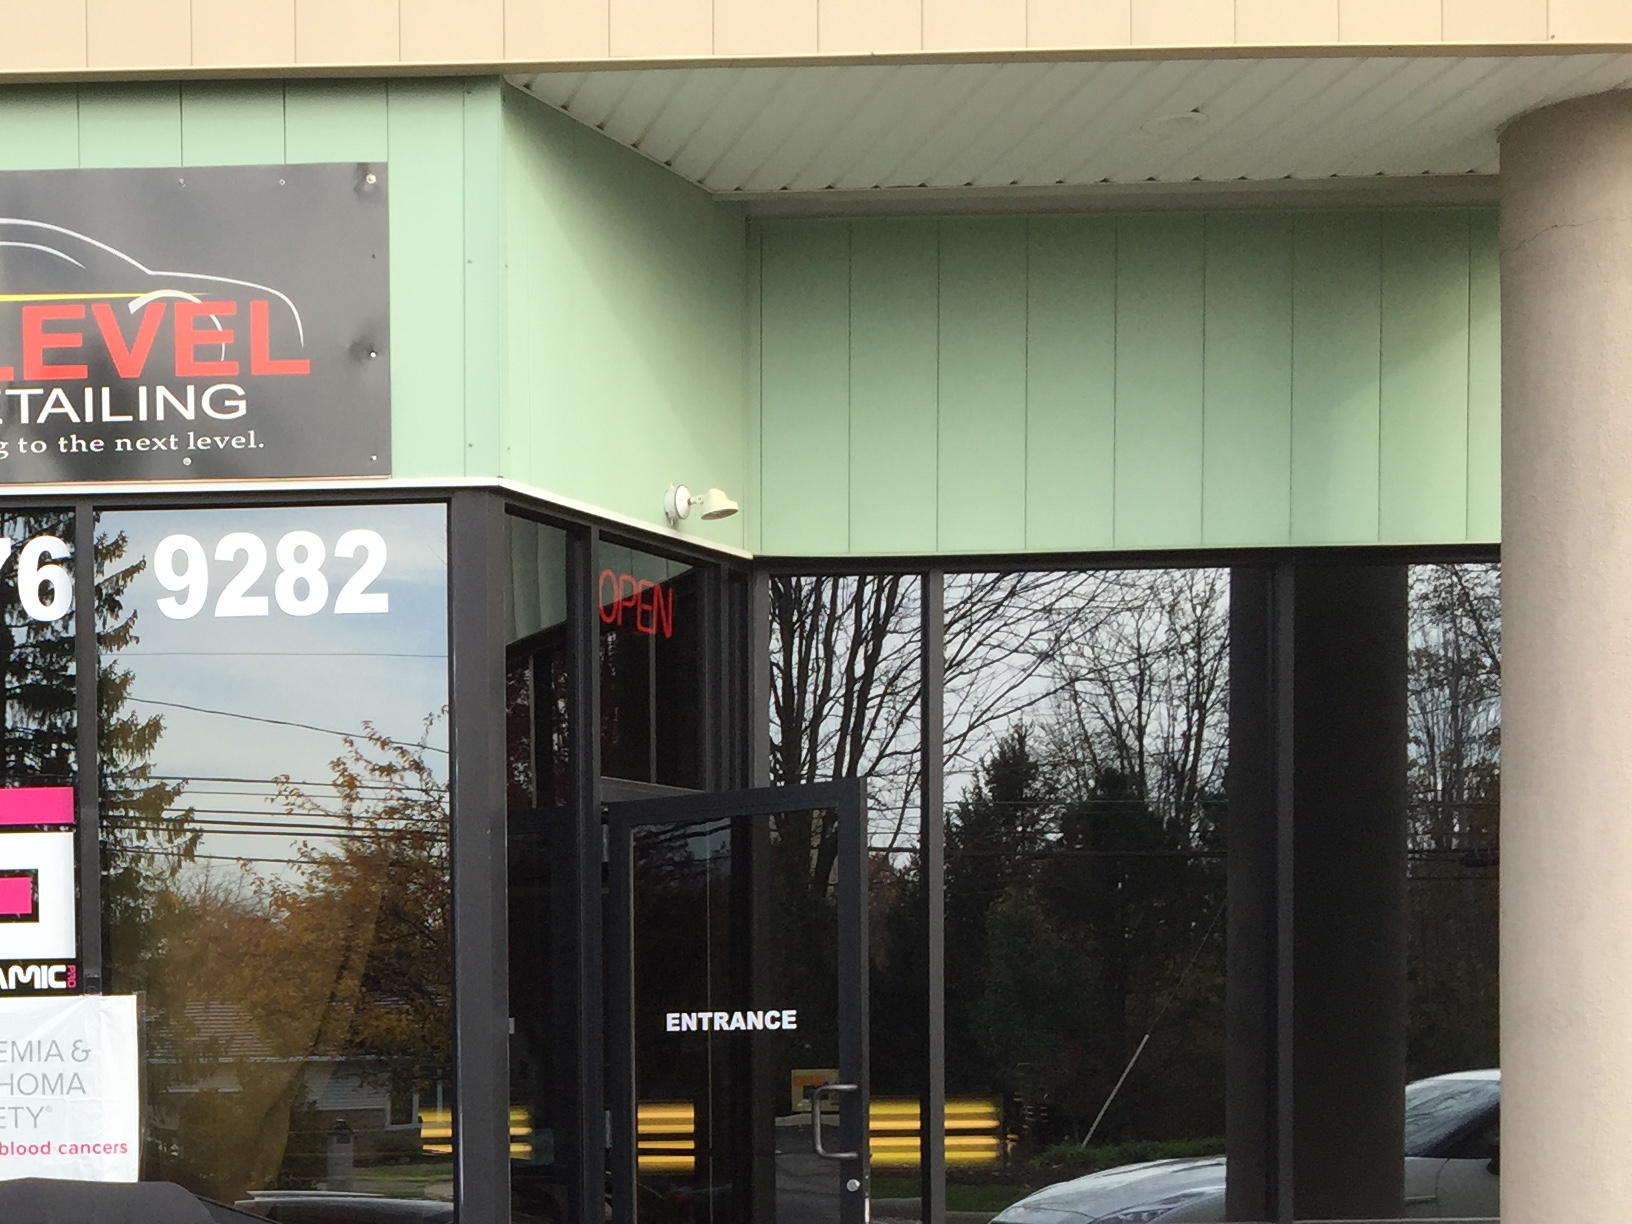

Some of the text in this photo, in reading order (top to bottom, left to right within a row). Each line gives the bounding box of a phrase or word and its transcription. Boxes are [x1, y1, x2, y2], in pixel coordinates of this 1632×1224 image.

[17, 436, 47, 454] to
[57, 434, 104, 453] the
[115, 433, 180, 452] next
[187, 430, 265, 450] level.
[153, 528, 390, 621] 9282
[598, 568, 674, 638] OPEN
[67, 964, 77, 989] PRO
[666, 1010, 798, 1032] ENTRANCE
[71, 1039, 92, 1063] &
[58, 1143, 128, 1156] cancers
